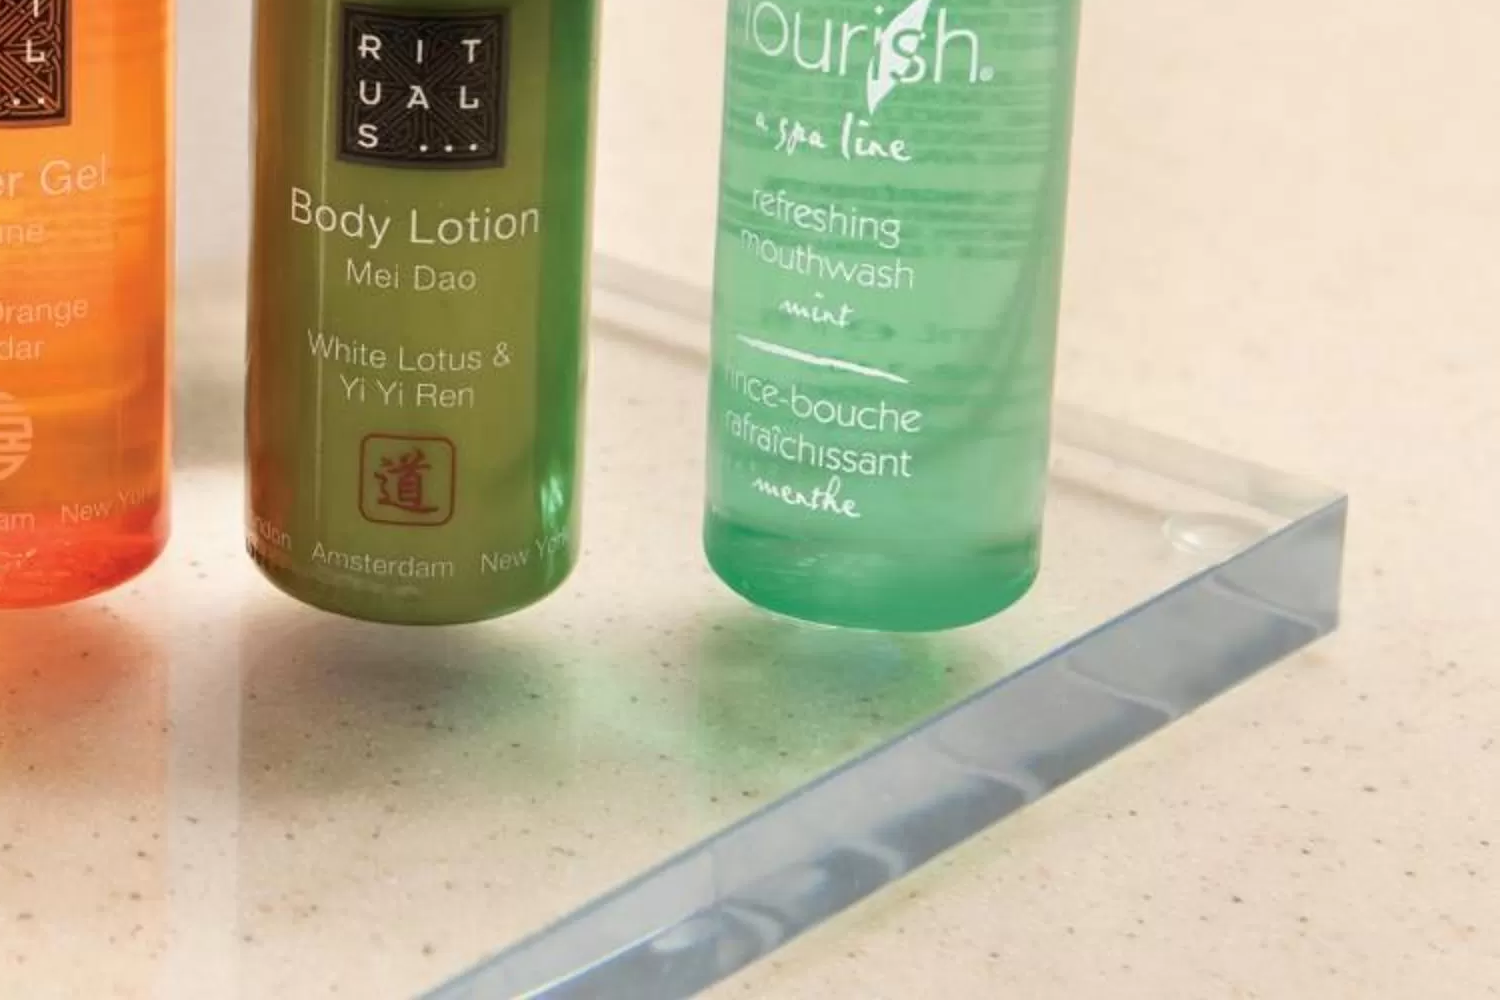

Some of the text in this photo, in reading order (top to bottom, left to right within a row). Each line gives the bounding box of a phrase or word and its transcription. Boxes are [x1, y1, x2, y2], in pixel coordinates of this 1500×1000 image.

[775, 115, 827, 155] spa
[841, 112, 912, 162] line
[40, 152, 108, 197] Gel
[290, 186, 540, 250] Body Lotion
[751, 188, 901, 249] refreshing
[346, 258, 477, 292] Mei Dao
[740, 228, 916, 290] mouthwash
[778, 291, 854, 328] mint
[307, 328, 512, 372] White Lotus &
[338, 374, 476, 409] Yi Yi Ren
[373, 445, 440, 515] 道
[752, 476, 861, 518] menthe
[60, 499, 111, 525] New
[311, 540, 454, 580] Amsterdam
[480, 548, 530, 575] New
